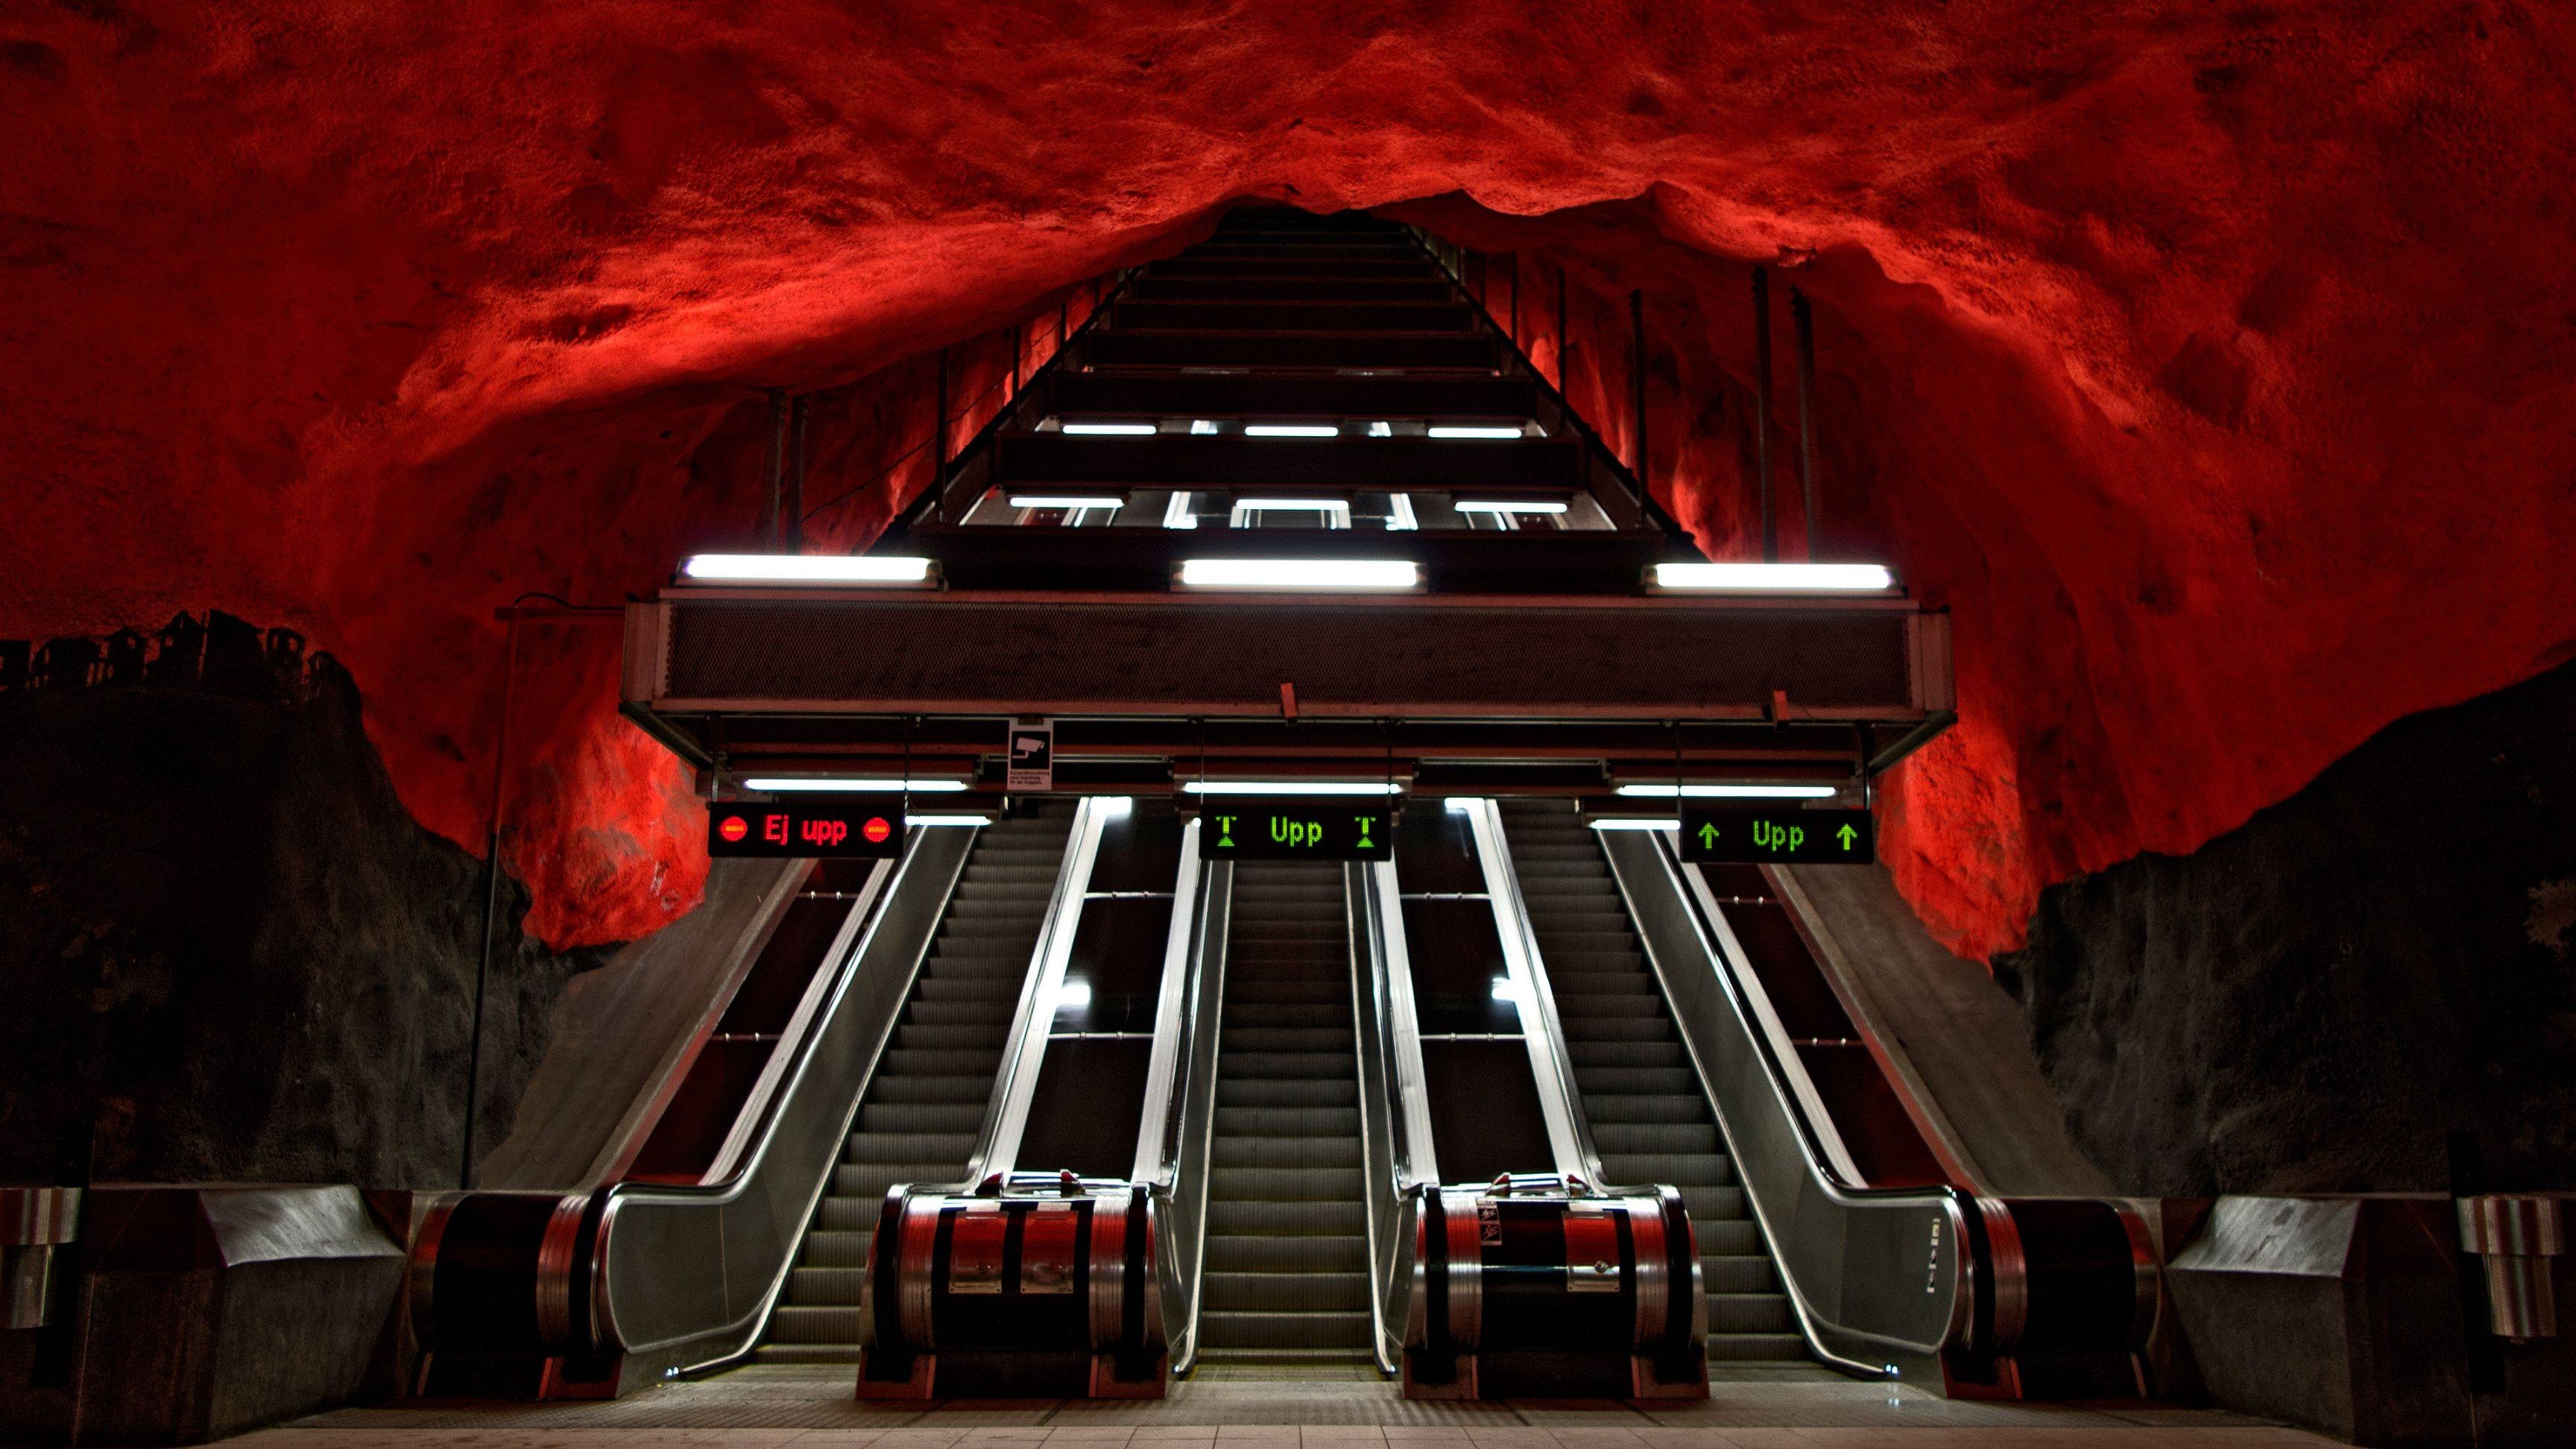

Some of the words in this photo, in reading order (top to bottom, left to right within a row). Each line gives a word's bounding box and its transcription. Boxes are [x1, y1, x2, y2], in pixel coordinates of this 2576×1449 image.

[764, 814, 789, 846] Ej
[801, 820, 847, 847] upp
[1271, 816, 1322, 847] Upp
[1753, 821, 1804, 852] Upp
